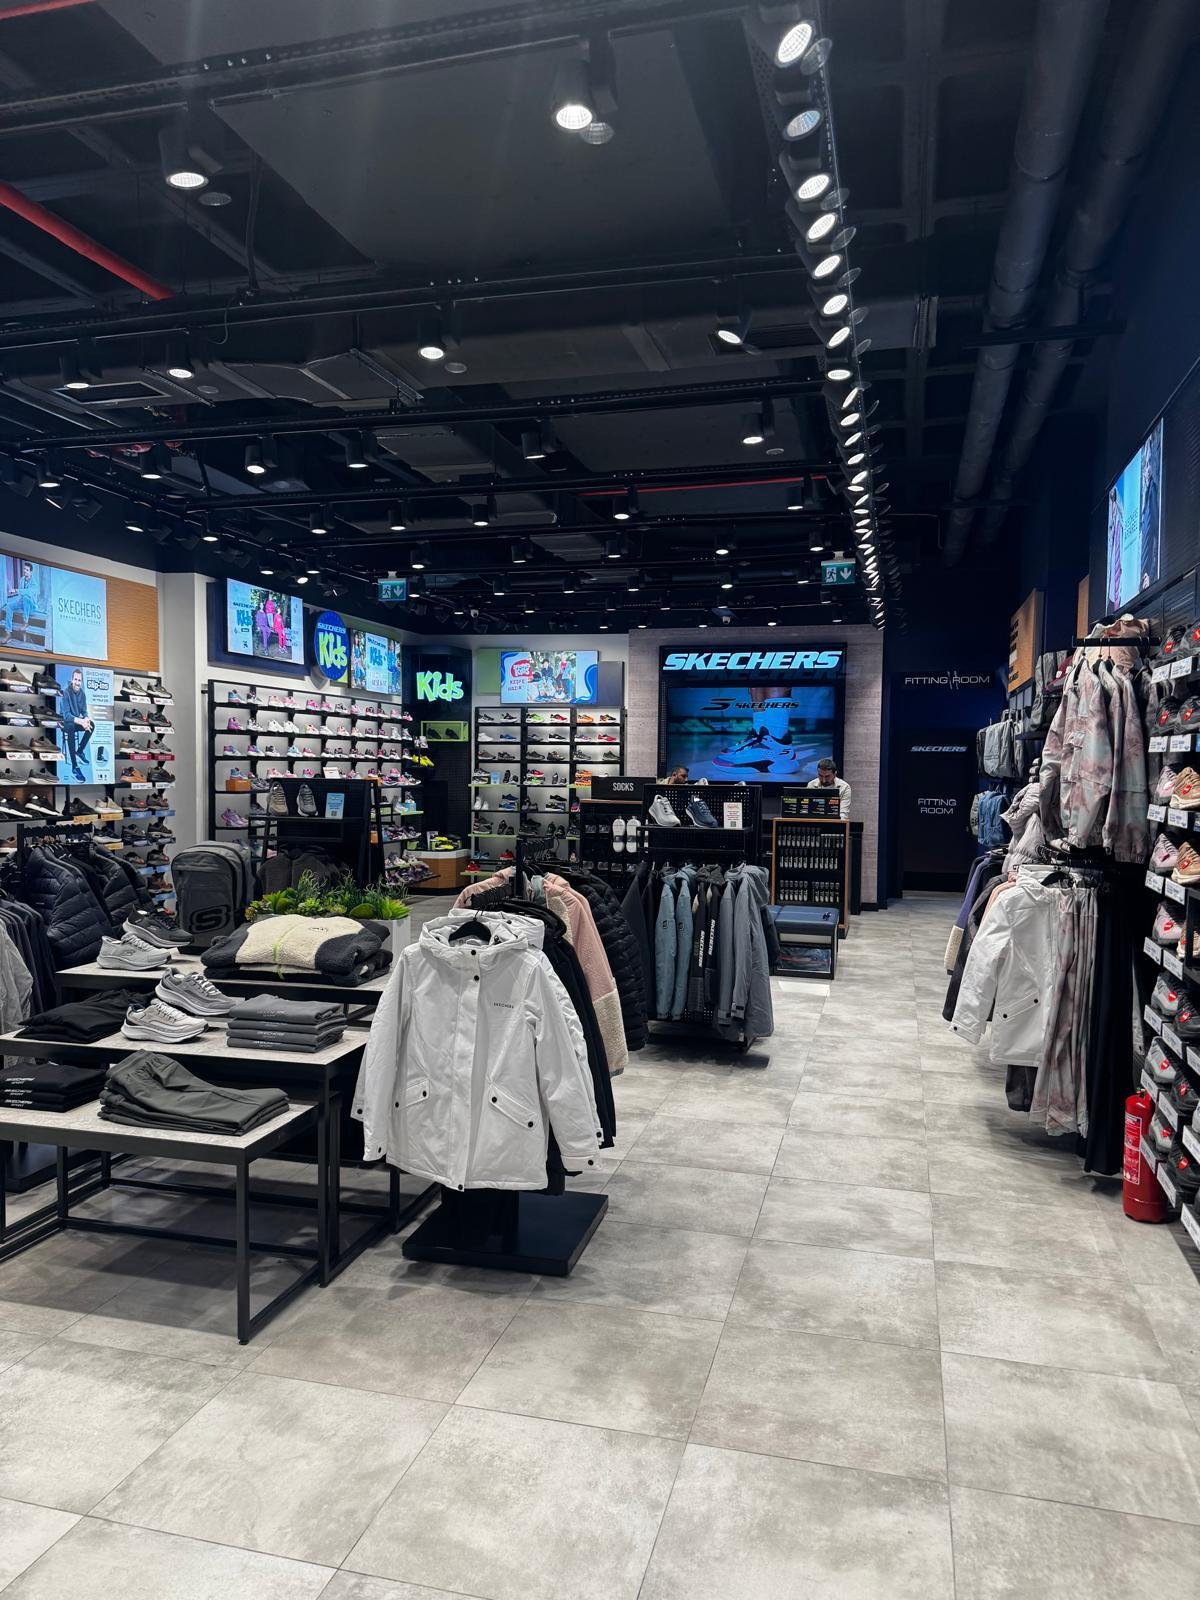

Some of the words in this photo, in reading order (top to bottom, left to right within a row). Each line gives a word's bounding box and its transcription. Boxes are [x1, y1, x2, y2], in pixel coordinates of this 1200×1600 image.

[58, 597, 102, 620] SKECHERS
[317, 622, 347, 634] SKECHERS
[318, 631, 348, 669] Kids
[662, 650, 843, 671] SKECHERS
[904, 676, 949, 685] FITTING
[952, 675, 990, 684] ROOM
[416, 670, 464, 702] Kids
[735, 701, 800, 709] SKECHERS
[612, 782, 635, 792] SOCKS
[917, 798, 957, 807] FITTING
[920, 807, 954, 815] ROOM
